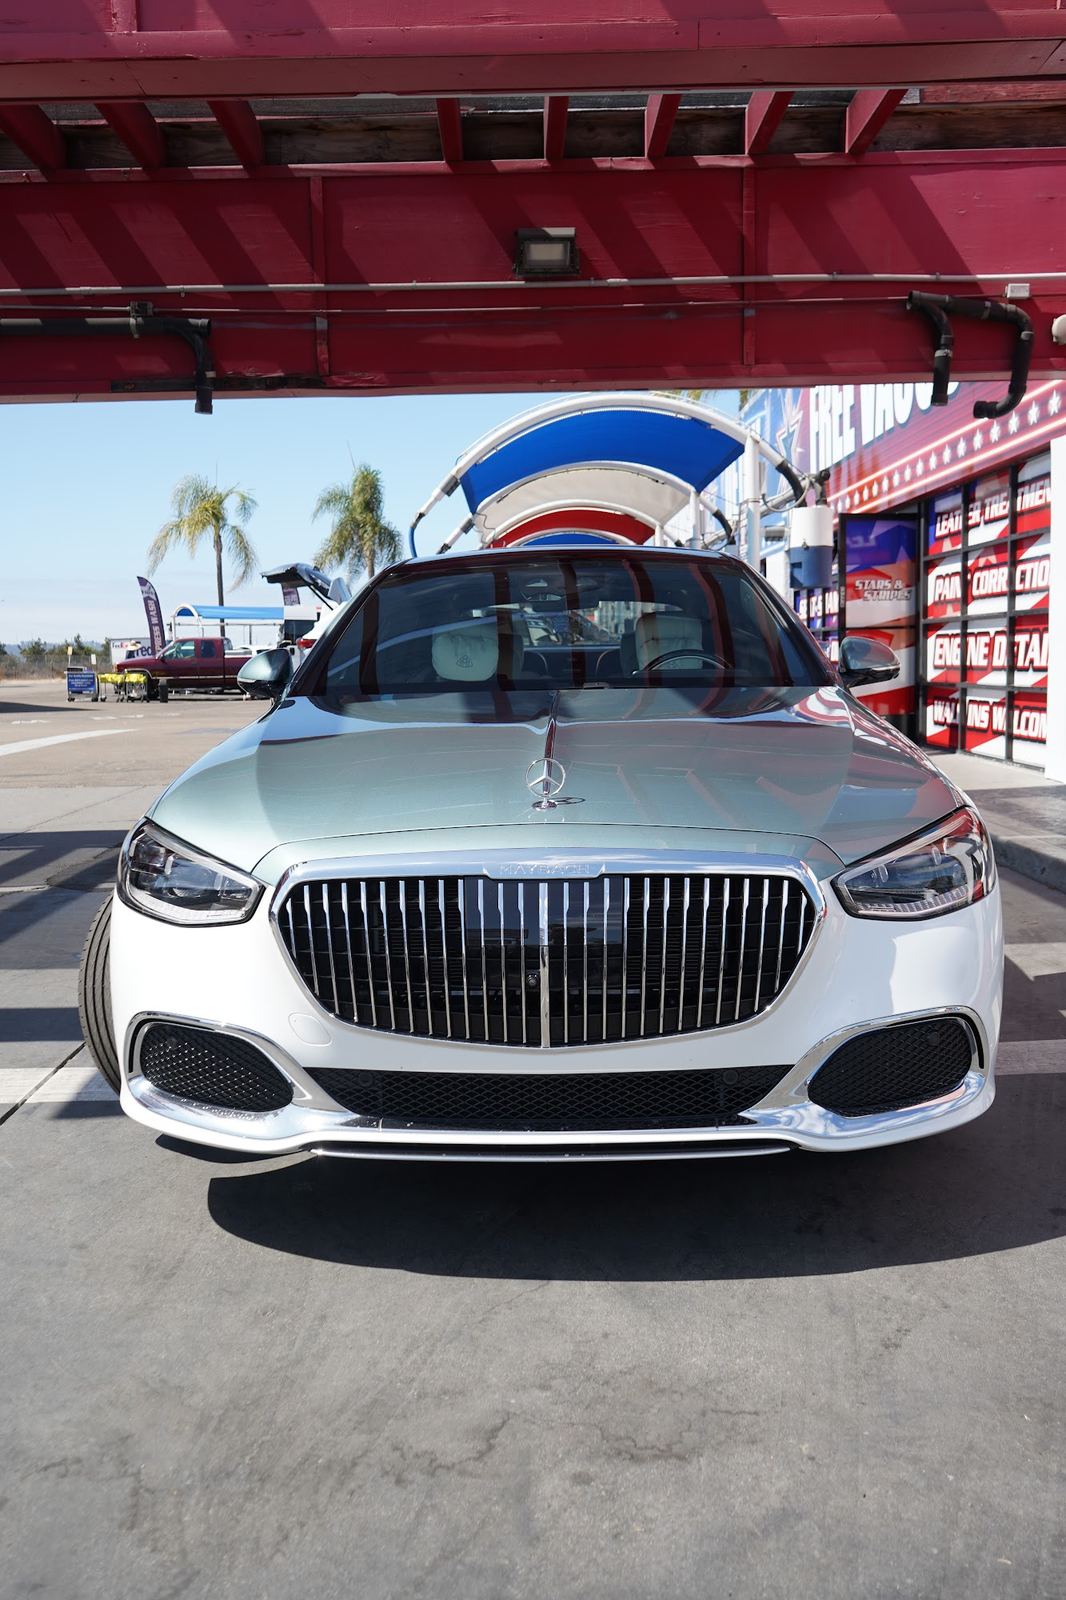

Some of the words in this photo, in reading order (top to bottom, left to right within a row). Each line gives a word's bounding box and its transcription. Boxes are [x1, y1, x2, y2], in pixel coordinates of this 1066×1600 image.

[809, 384, 856, 474] FREE
[935, 500, 981, 538] LEATER
[984, 479, 1050, 521] TRETMEN
[855, 579, 892, 590] STARS
[863, 590, 912, 601] STRIPES
[935, 572, 971, 601] PAIN
[972, 560, 1050, 596] CORRCTIO
[934, 634, 990, 666] ENGNE
[992, 705, 1047, 738] WLCOM
[499, 863, 591, 875] MAYBACH
